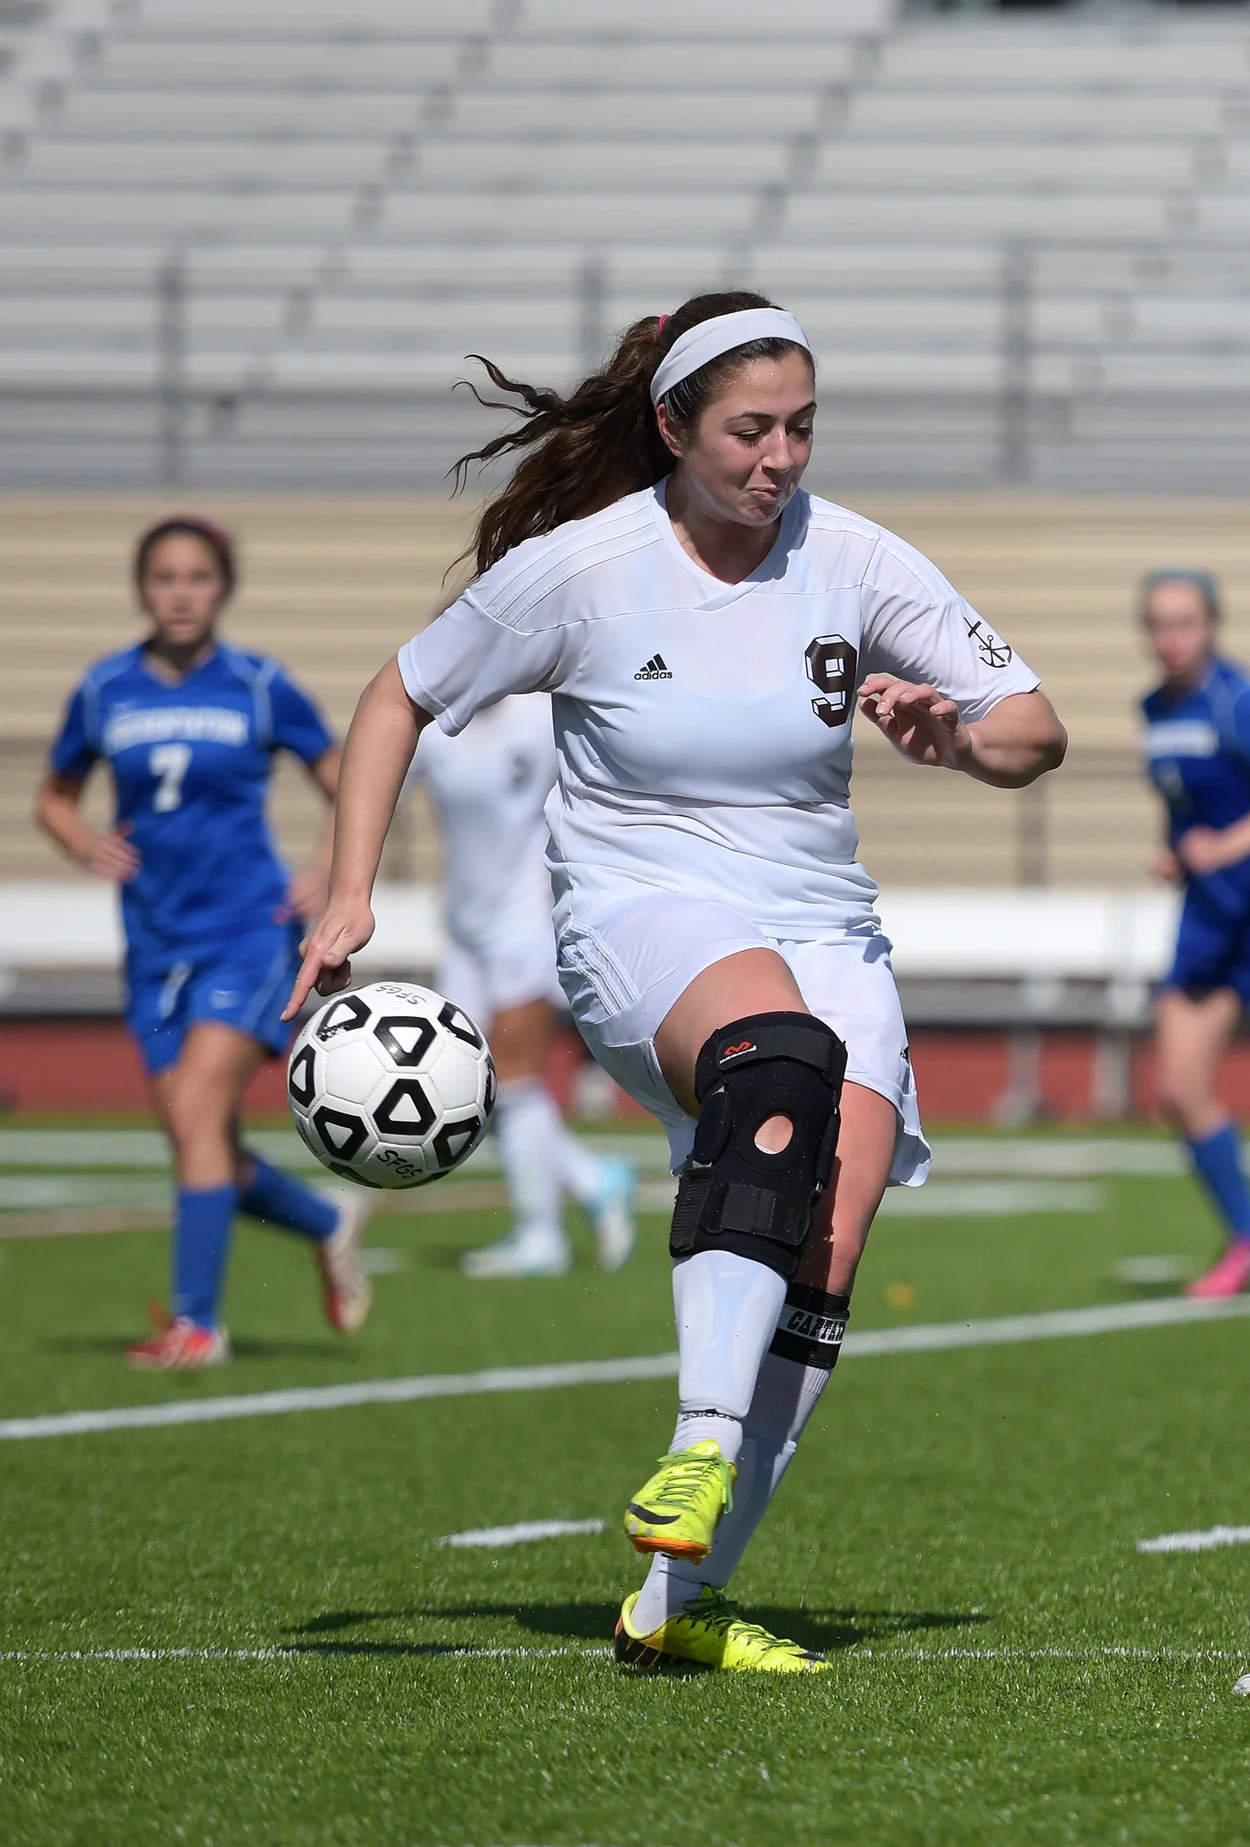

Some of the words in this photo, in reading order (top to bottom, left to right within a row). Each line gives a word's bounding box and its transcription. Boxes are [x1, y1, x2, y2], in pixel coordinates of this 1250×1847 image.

[633, 670, 673, 681] adidas
[804, 633, 858, 728] 9
[149, 743, 192, 813] 7
[376, 1149, 424, 1178] SFGS
